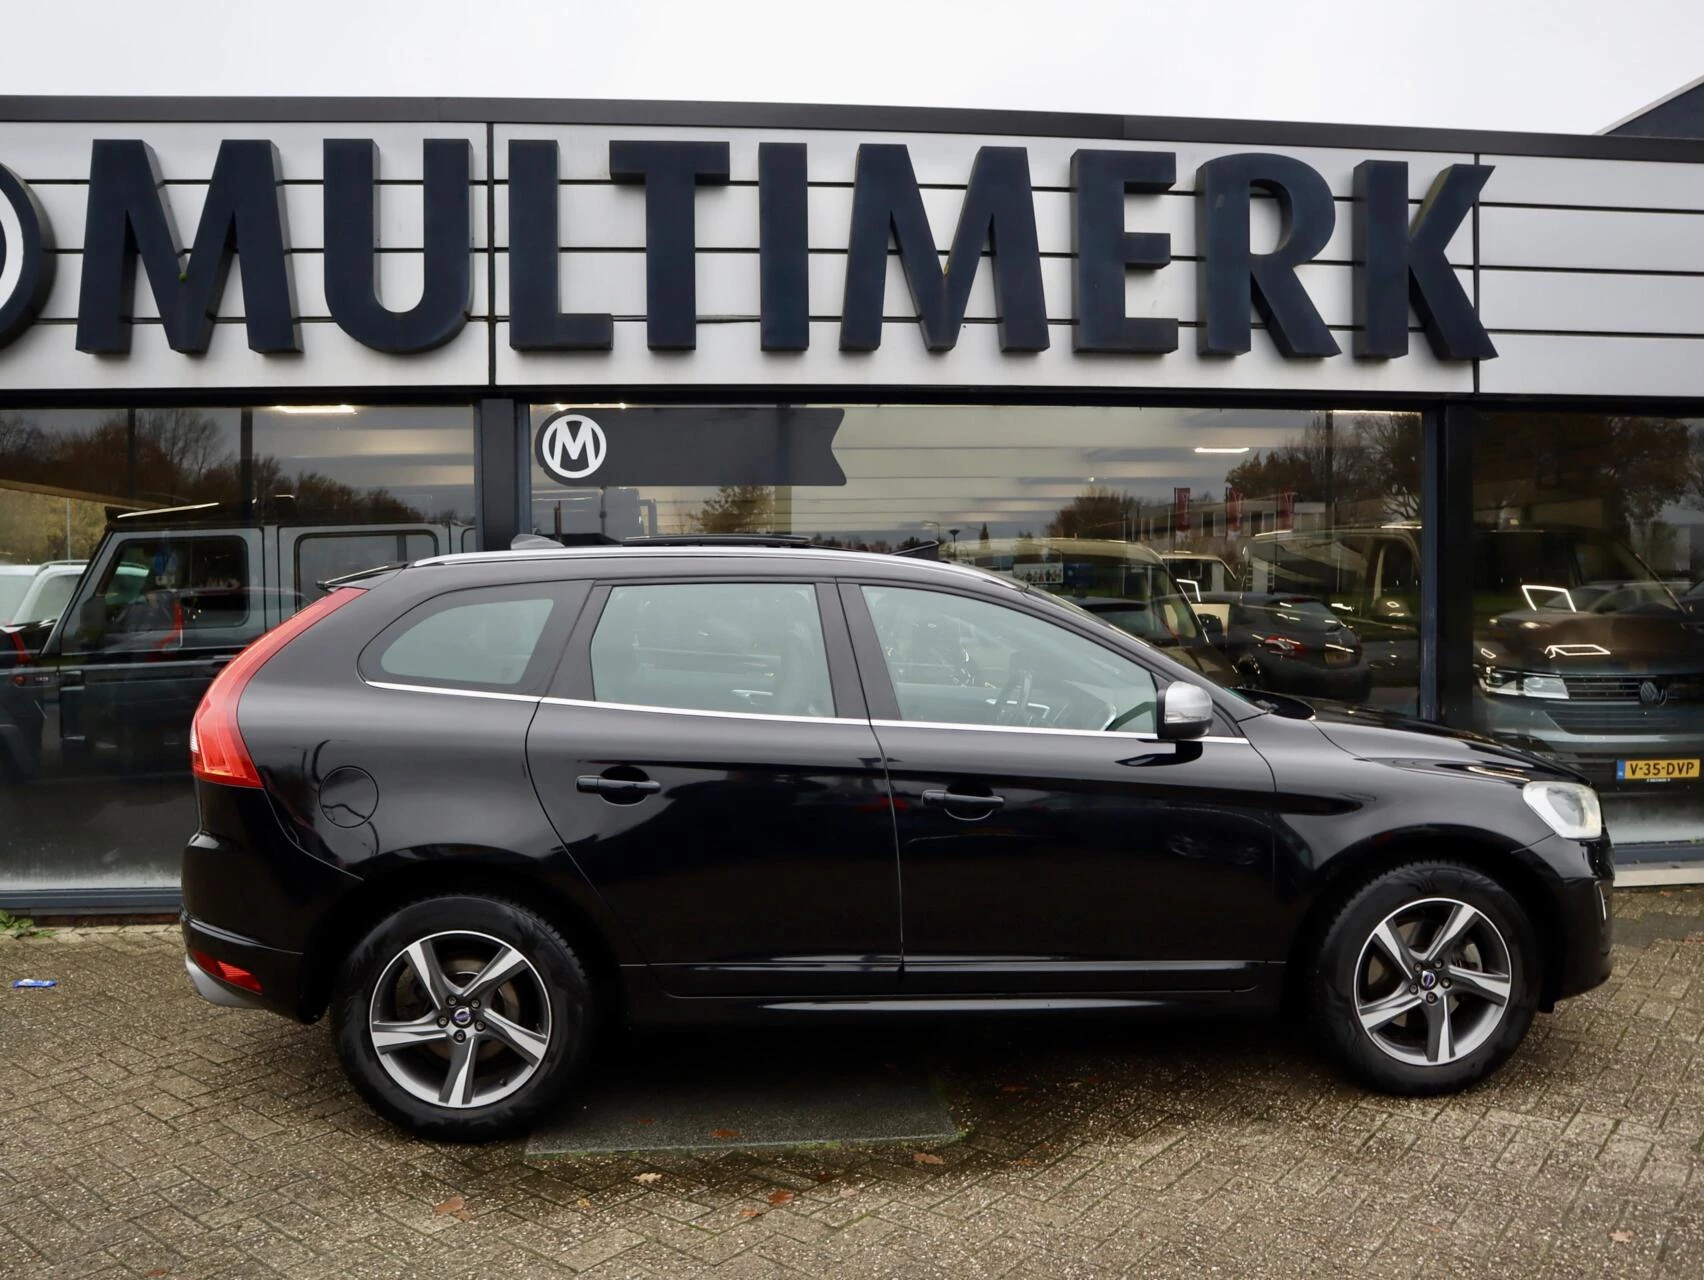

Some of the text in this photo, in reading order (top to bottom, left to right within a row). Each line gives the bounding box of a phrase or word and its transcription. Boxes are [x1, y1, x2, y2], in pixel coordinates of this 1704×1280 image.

[76, 138, 1499, 360] MULTIMERK
[545, 415, 604, 477] M
[1629, 761, 1695, 777] V-35-DVP
